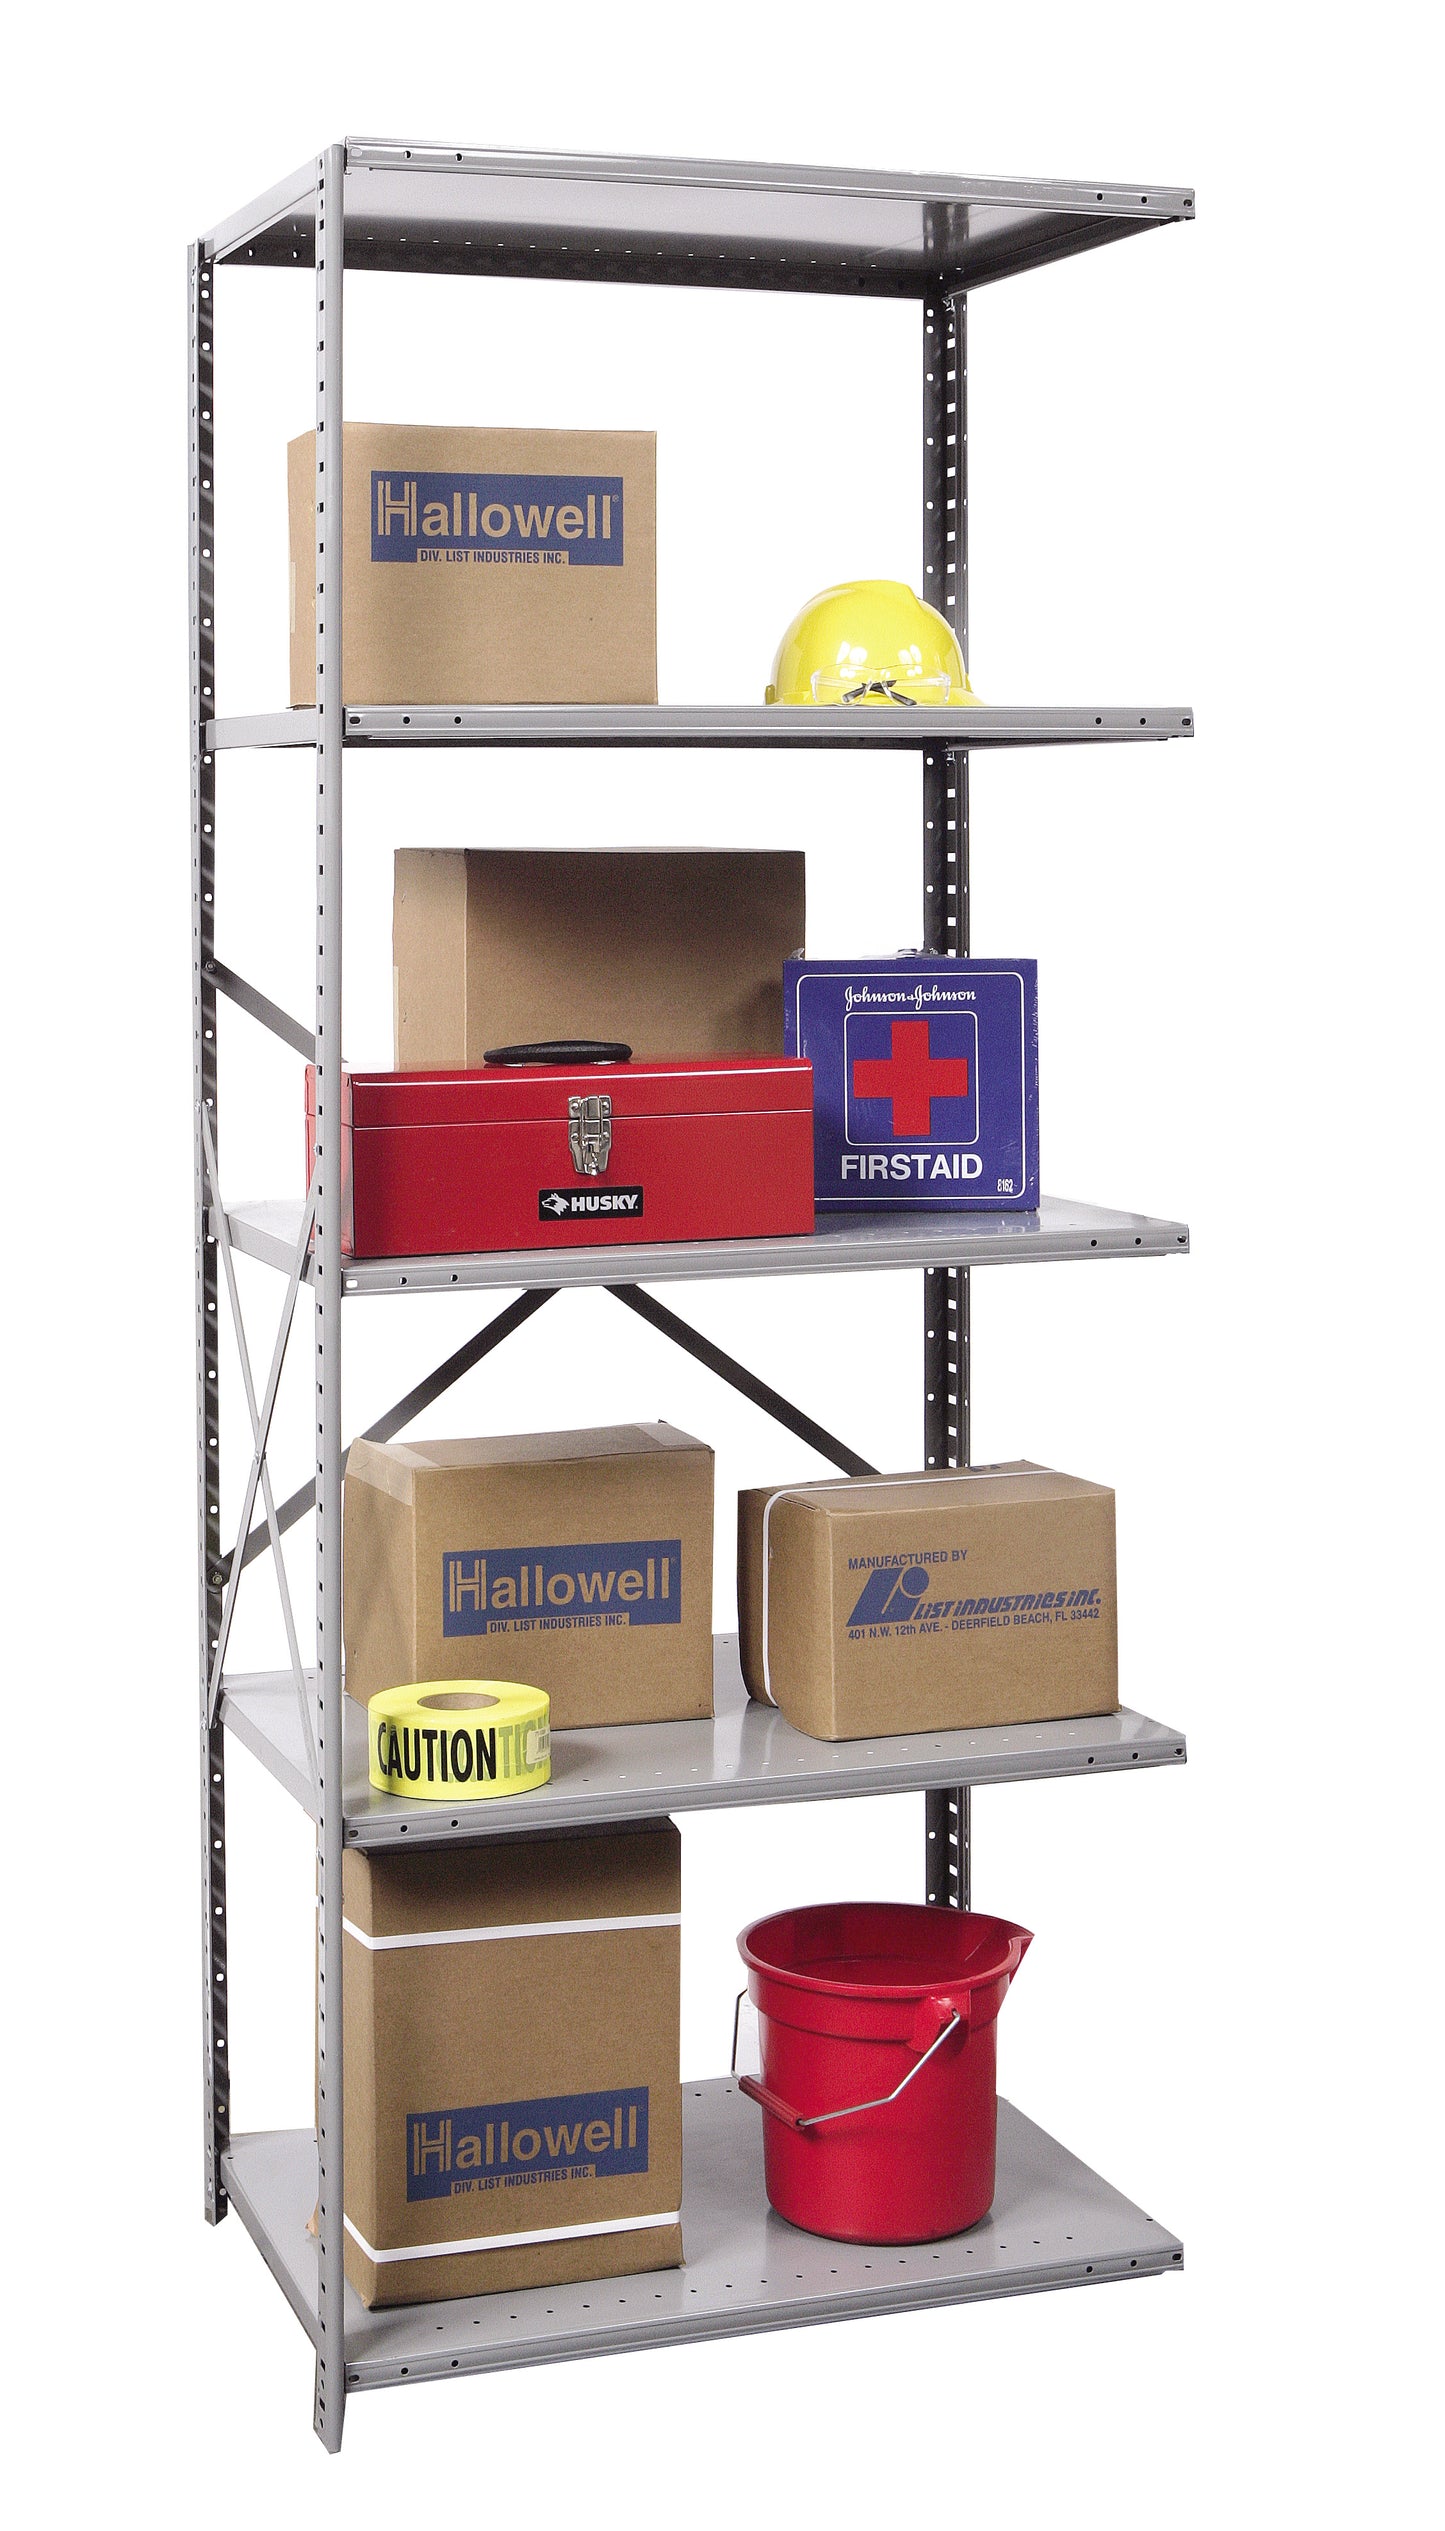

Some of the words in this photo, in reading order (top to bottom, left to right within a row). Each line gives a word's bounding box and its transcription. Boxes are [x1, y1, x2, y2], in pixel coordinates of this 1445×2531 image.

[420, 549, 442, 562] DIV.
[445, 550, 470, 563] LIST
[473, 551, 540, 564] INDUSTRIES
[543, 553, 566, 565] INC.
[844, 986, 906, 1011] Johnson
[914, 984, 976, 1010] Johnson
[848, 1550, 949, 1570] MANUFACTURED
[951, 1549, 968, 1562] BY
[490, 1622, 510, 1633] DIV.
[513, 1619, 537, 1632] LIST
[539, 1615, 602, 1630] INDUSTRIES
[605, 1613, 626, 1626] INC.
[848, 1629, 866, 1640] 401
[869, 1627, 892, 1638] N.W.
[895, 1624, 916, 1636] 12th
[919, 1622, 943, 1634] AVE.
[951, 1615, 1010, 1631] DEERFIELD
[1013, 1612, 1053, 1625] BEACH,
[1055, 1610, 1068, 1622] FL
[1070, 1608, 1100, 1620] 33442
[377, 1721, 497, 1783] CAUTION
[454, 2181, 475, 2194] DIV.
[478, 2177, 501, 2191] LIST
[504, 2169, 568, 2188] INDUSTRIES
[571, 2167, 593, 2179] INC.
